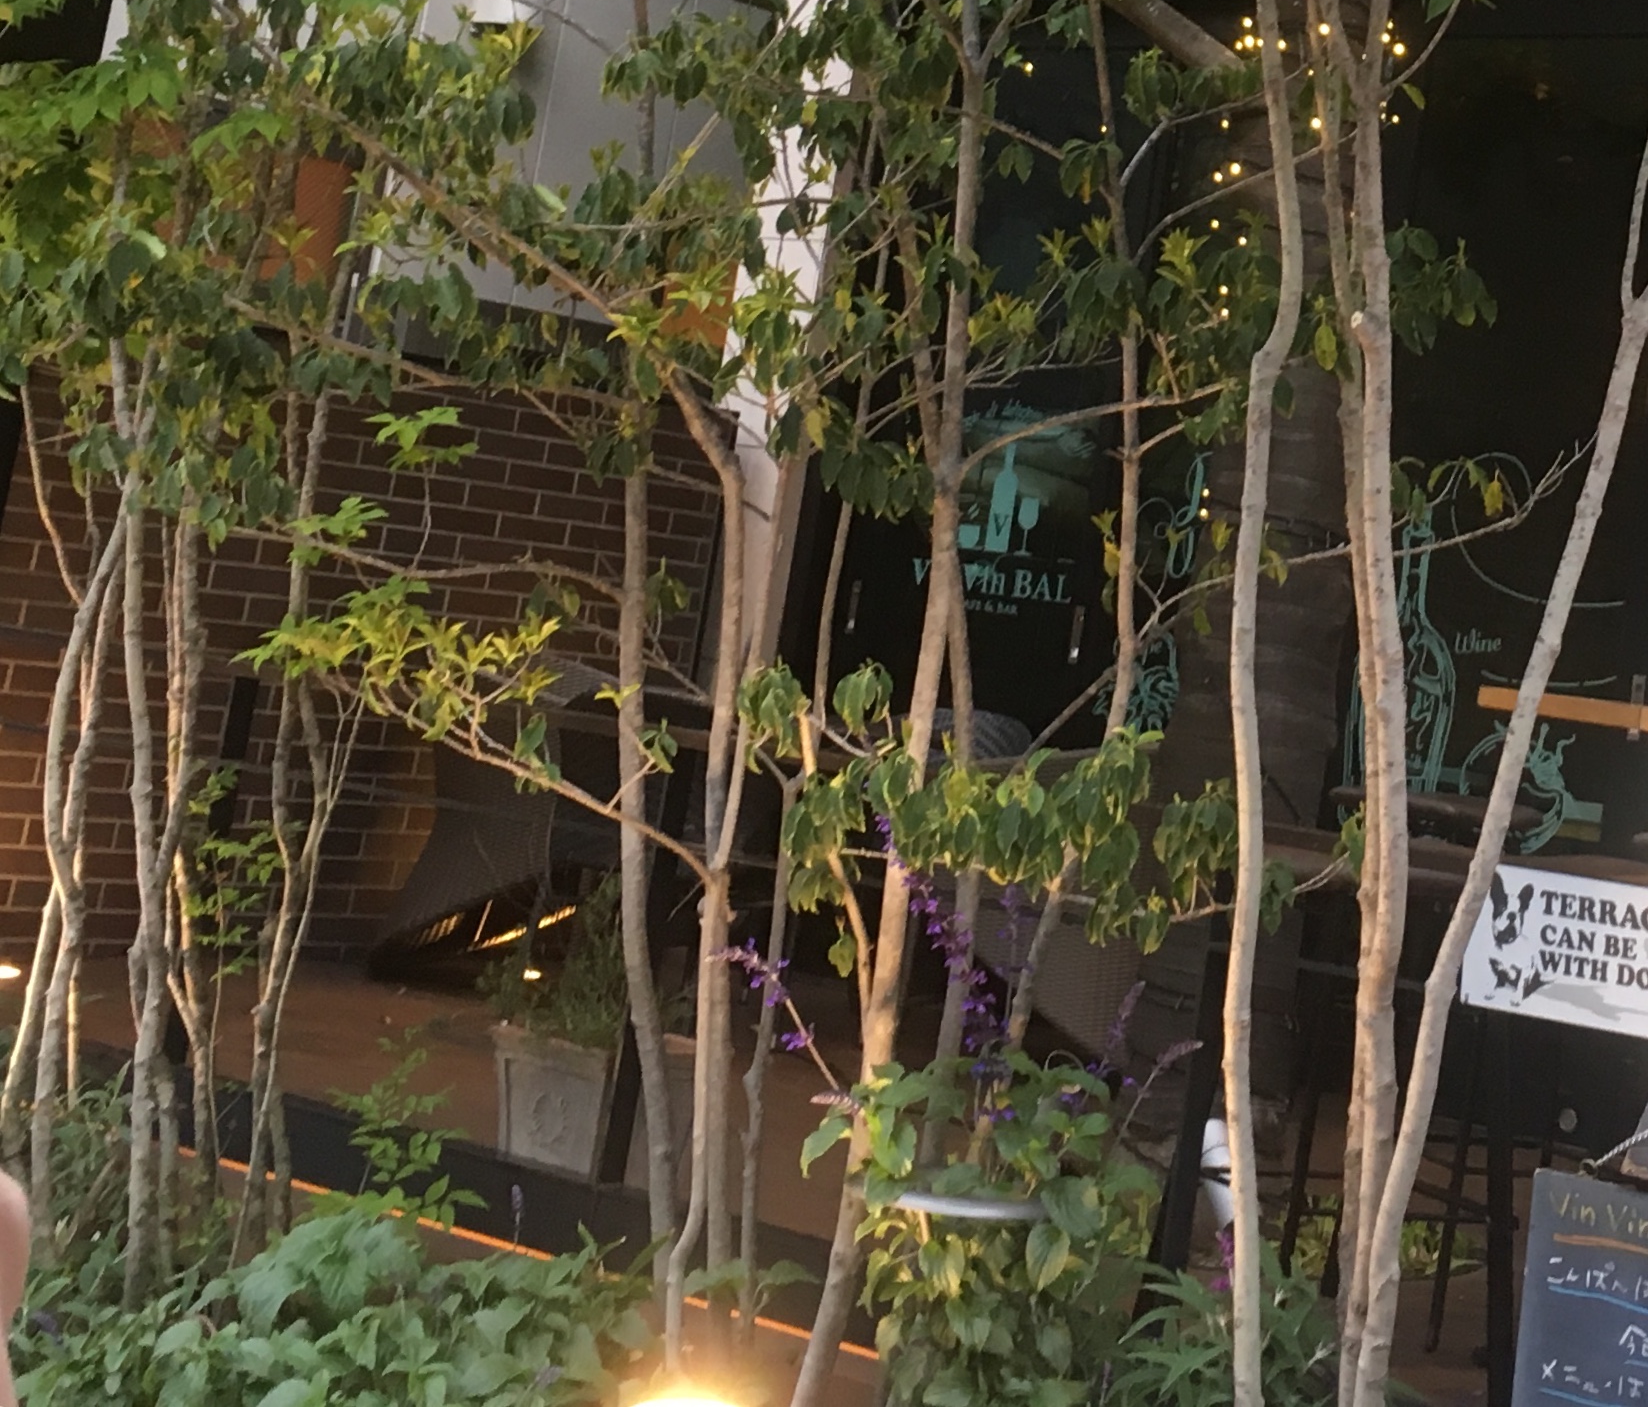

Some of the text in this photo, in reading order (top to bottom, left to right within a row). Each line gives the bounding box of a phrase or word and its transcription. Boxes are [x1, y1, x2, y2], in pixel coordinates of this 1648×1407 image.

[1011, 568, 1073, 604] BAL
[1454, 629, 1503, 655] Wine
[1540, 924, 1638, 961] CAN BE
[1539, 950, 1608, 983] WITH
[1550, 1192, 1596, 1226] Vin
